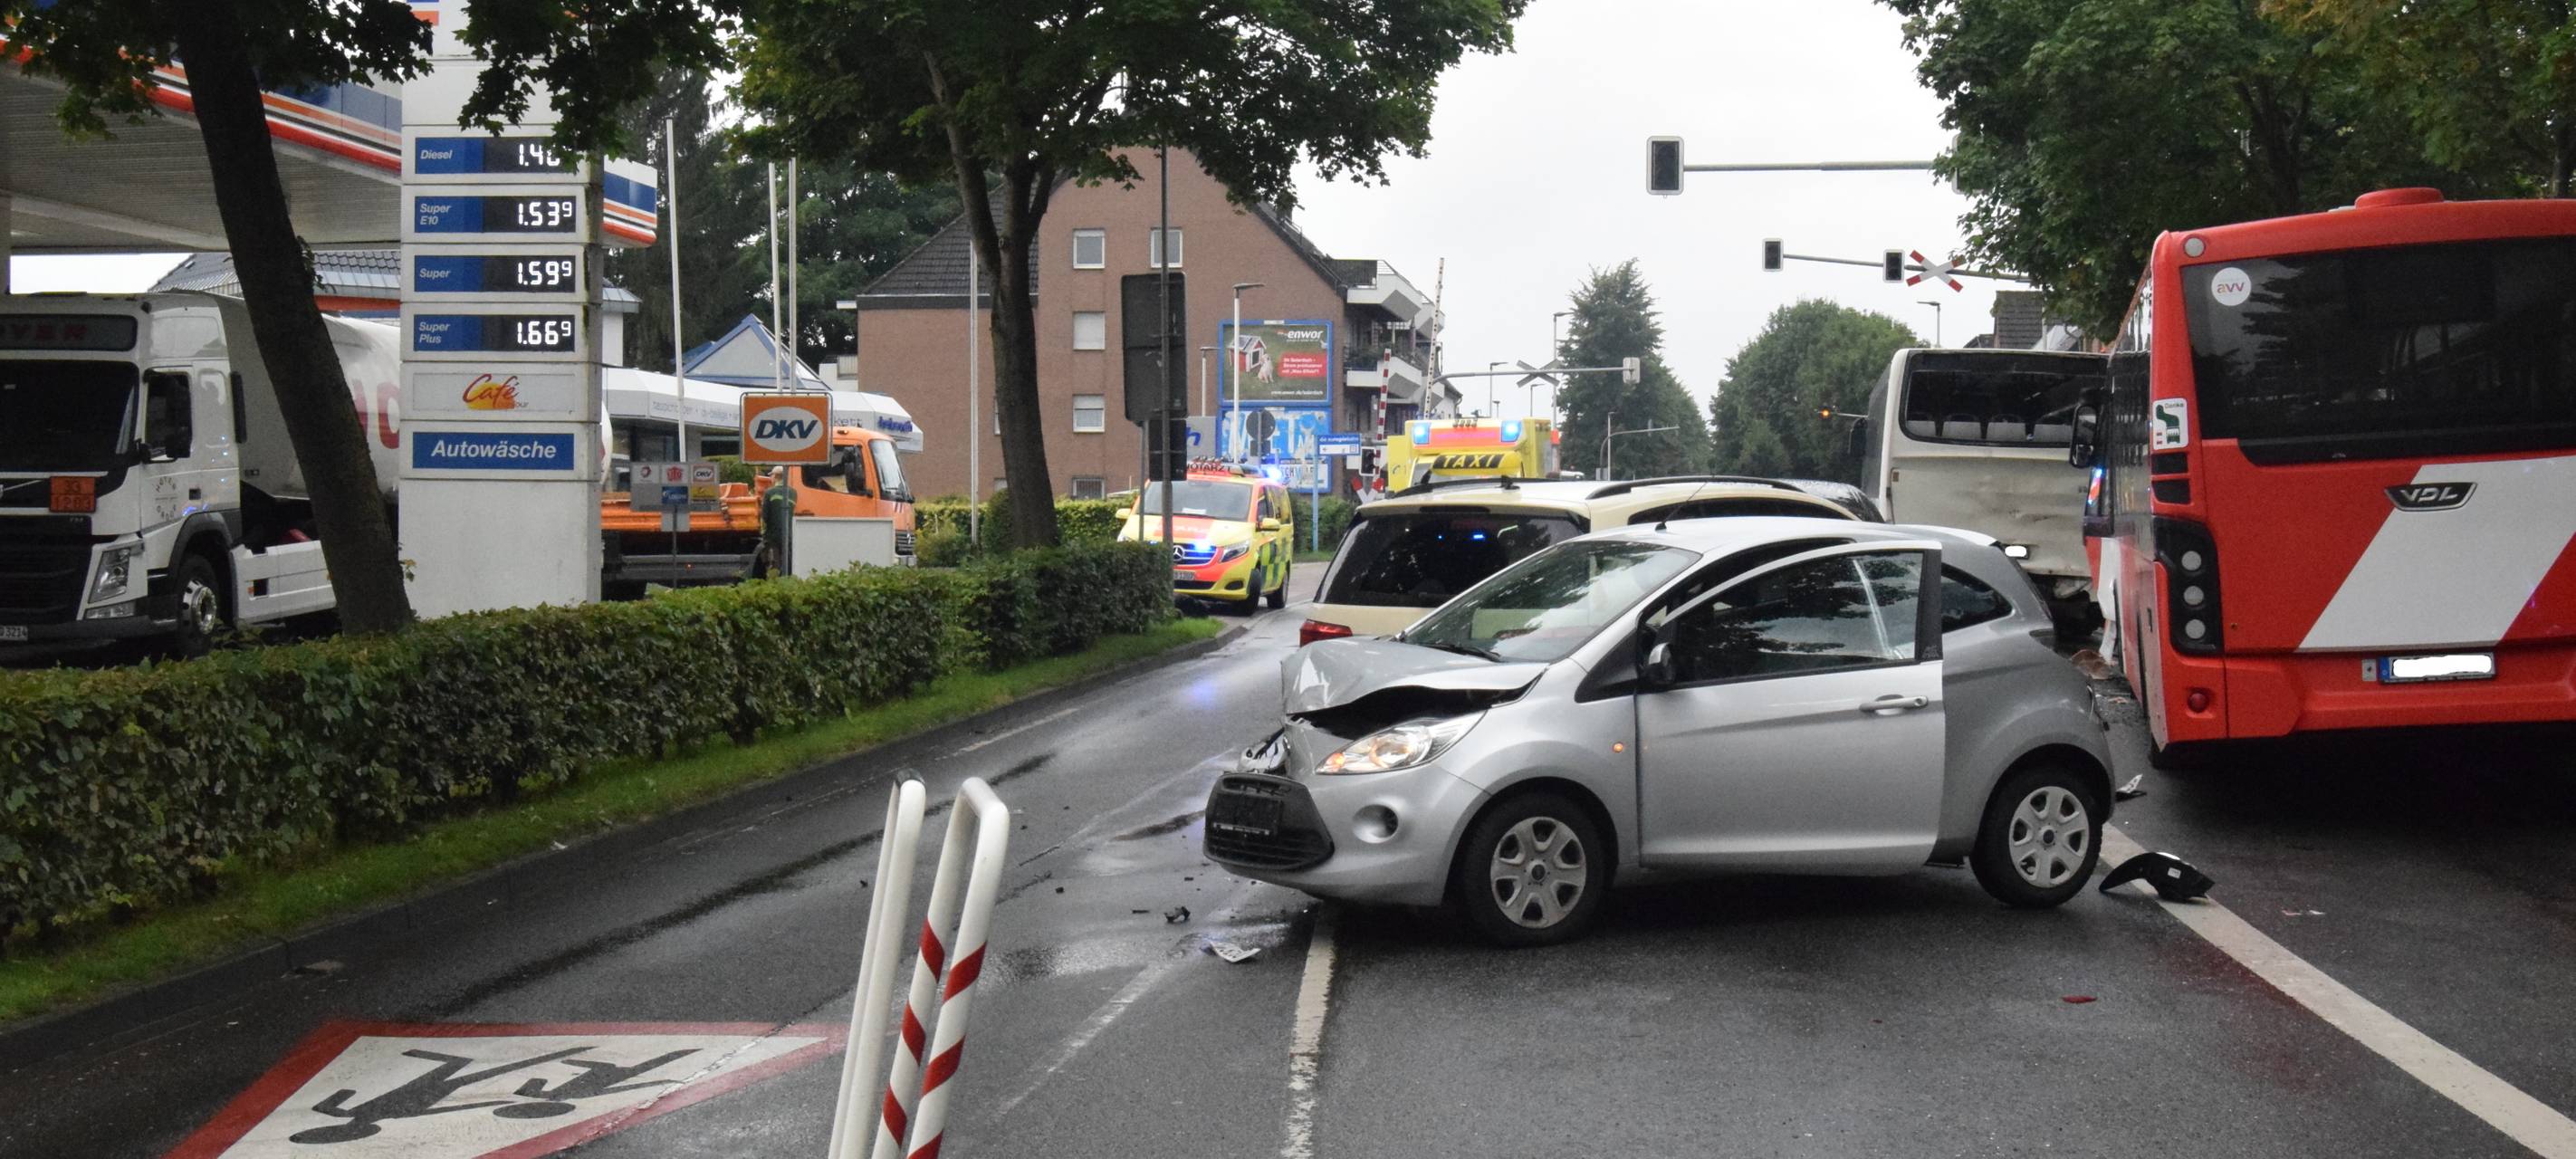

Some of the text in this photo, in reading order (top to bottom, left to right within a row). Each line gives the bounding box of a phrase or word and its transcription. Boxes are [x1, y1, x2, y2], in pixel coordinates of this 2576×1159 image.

[420, 149, 453, 159] Diesel
[419, 203, 451, 214] Super
[419, 216, 438, 225] E10
[419, 268, 451, 279] Super
[2217, 282, 2245, 293] avv
[418, 321, 451, 332] Super
[418, 334, 442, 343] Plus
[1288, 330, 1324, 339] enwor
[463, 373, 520, 408] Café
[754, 419, 819, 440] DKV
[431, 439, 557, 458] Autowäsche
[1442, 454, 1499, 468] TAXI
[2399, 486, 2458, 503] VDL
